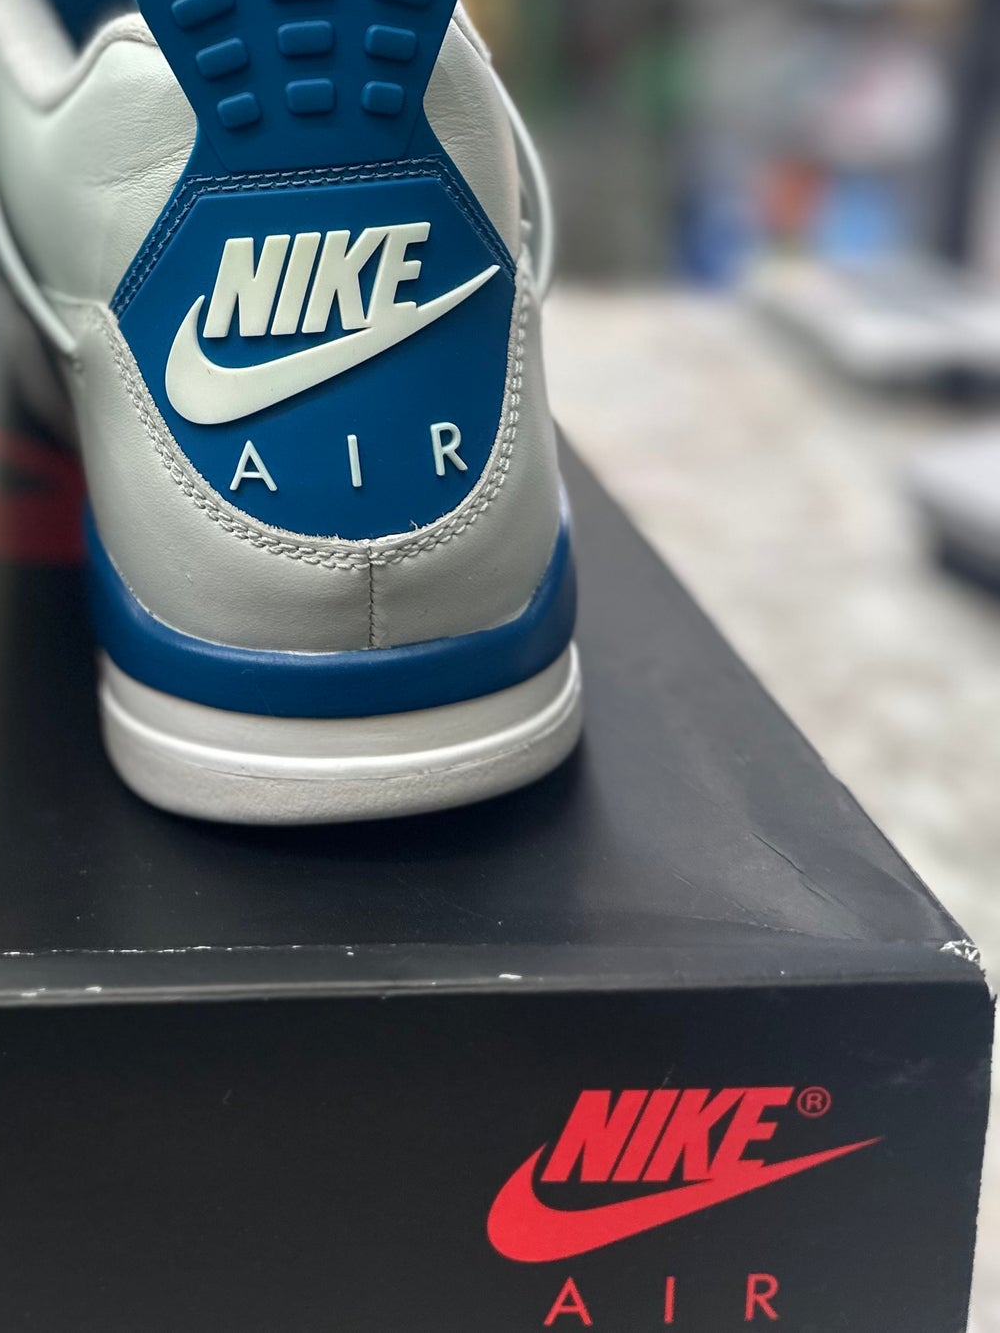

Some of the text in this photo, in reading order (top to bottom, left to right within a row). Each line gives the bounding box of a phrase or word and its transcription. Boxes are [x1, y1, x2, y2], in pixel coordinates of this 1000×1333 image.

[203, 222, 431, 338] NIKE
[230, 422, 468, 491] AIR
[544, 1273, 780, 1327] AIR
